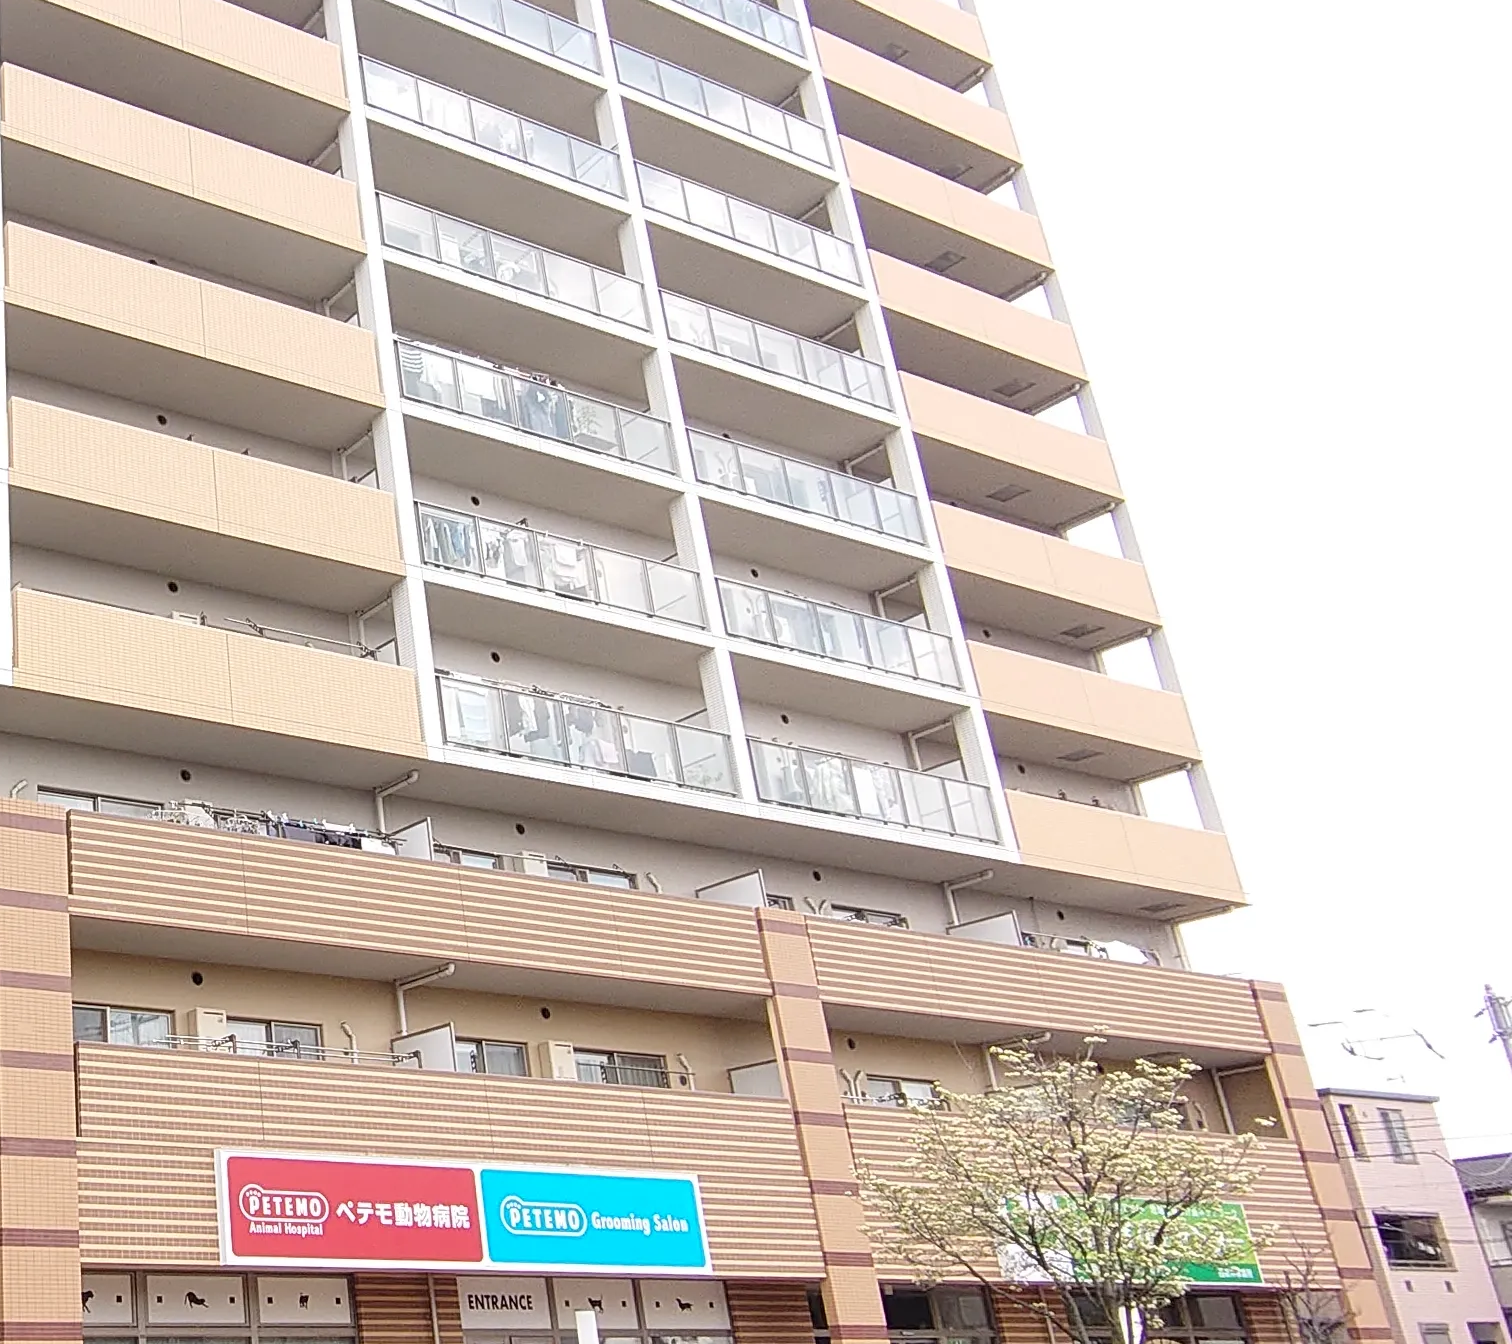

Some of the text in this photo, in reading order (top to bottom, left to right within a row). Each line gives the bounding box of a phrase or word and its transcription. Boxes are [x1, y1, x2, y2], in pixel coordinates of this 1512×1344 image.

[248, 1195, 322, 1218] PETEMO
[336, 1200, 471, 1230] ペテモ動物病院
[509, 1206, 581, 1231] PETEMO
[249, 1221, 324, 1238] Animal Hospital
[591, 1211, 688, 1237] Grooming Salon
[467, 1294, 534, 1311] ENTRANCE
